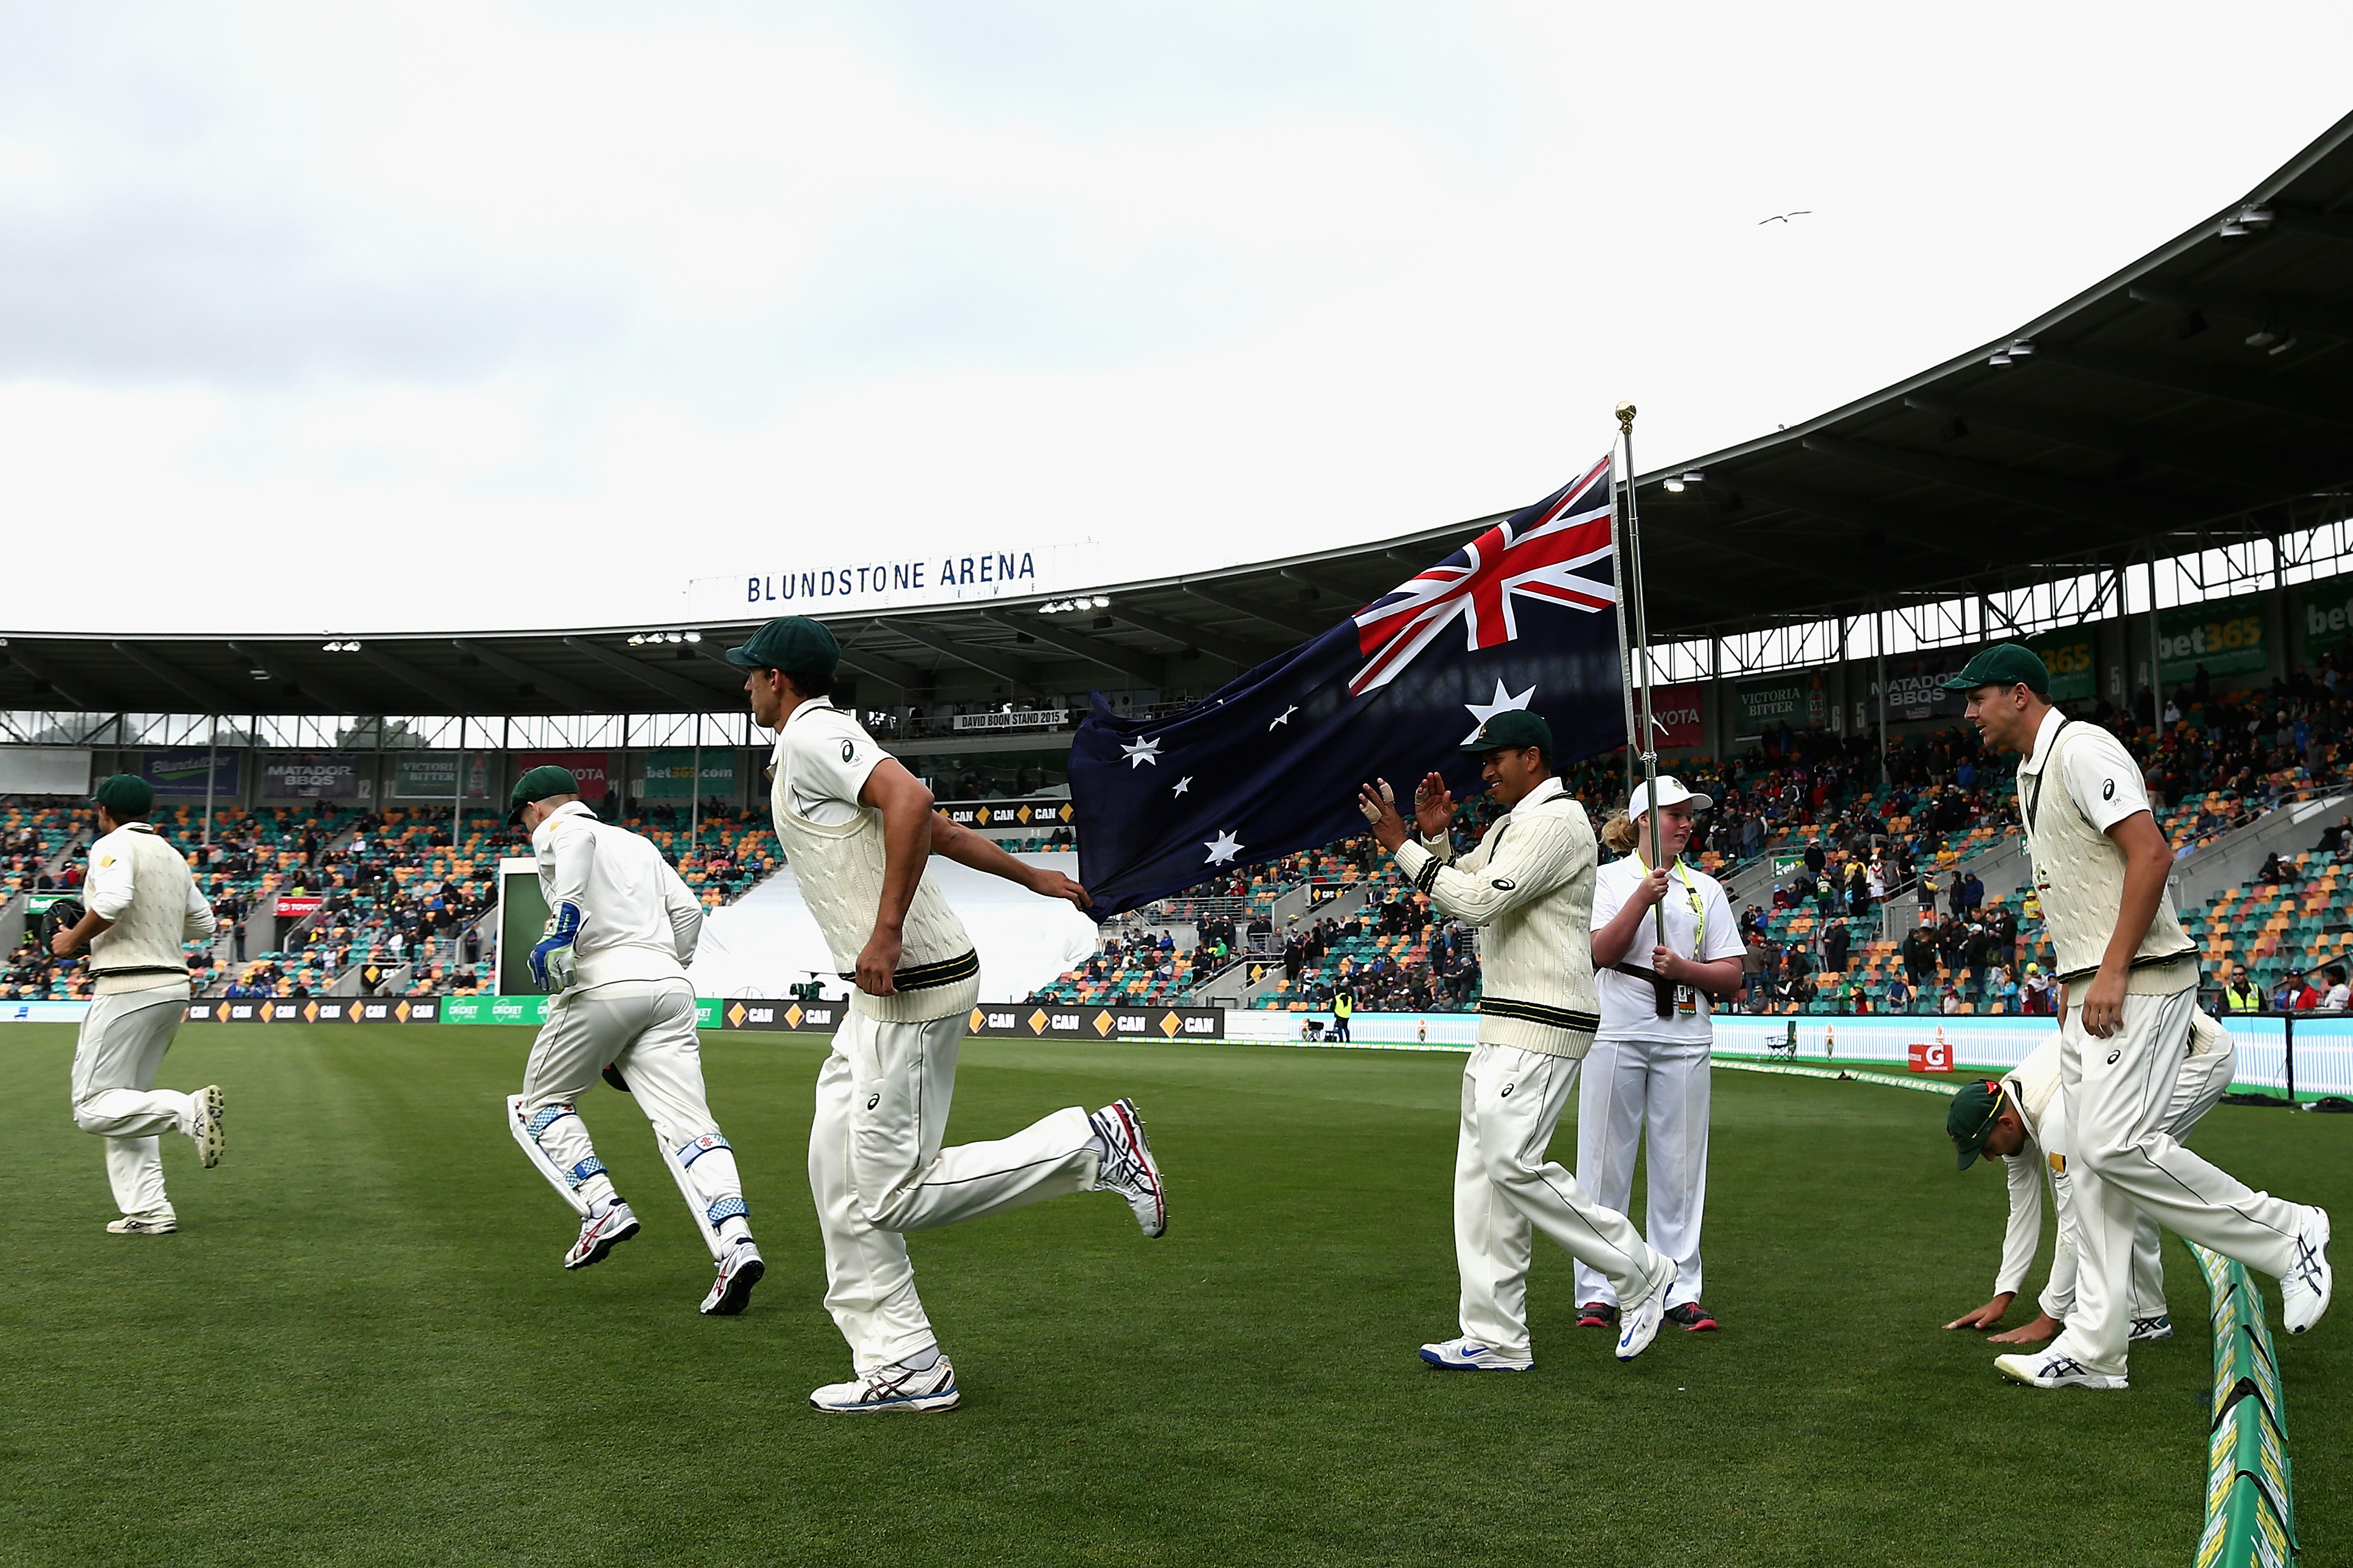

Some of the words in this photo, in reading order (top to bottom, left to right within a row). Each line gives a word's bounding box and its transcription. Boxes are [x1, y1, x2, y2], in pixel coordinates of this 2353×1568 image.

[747, 562, 924, 603] BLUNDSTONE
[940, 552, 1034, 585] ARENA
[2159, 616, 2261, 658] bet365
[2035, 643, 2090, 675] 365
[2111, 667, 2120, 695] 5
[1741, 688, 1801, 705] VICTORIA
[1890, 688, 1946, 706] BBQS
[1748, 700, 1793, 716] BITTER
[1857, 702, 1865, 728] 5
[962, 717, 985, 727] DAVID
[988, 714, 1010, 726] BOON
[1012, 713, 1038, 725] STAND
[1041, 711, 1059, 722] 2015
[1635, 708, 1699, 728] TYOTA
[1832, 706, 1840, 731] 6
[268, 766, 355, 775] MATADOR
[409, 772, 454, 781] BITTER
[646, 766, 733, 778] bet365.com
[285, 776, 334, 786] BBQS
[953, 811, 973, 822] CAN
[994, 810, 1014, 821] CAN
[1035, 808, 1056, 820] CAN
[30, 898, 60, 909] bet
[190, 1006, 210, 1018] CAN
[232, 1006, 252, 1018] CAN
[275, 1005, 297, 1018] CAN
[320, 1005, 341, 1018] CAN
[365, 1005, 387, 1018] CAN
[412, 1005, 434, 1018] CAN
[749, 1008, 774, 1023] CAN
[805, 1009, 831, 1024] CAN
[988, 1013, 1015, 1028] CAN
[1052, 1014, 1079, 1030] CAN
[1117, 1016, 1146, 1032] CAN
[1185, 1017, 1214, 1033] CAN
[1925, 1045, 1945, 1066] G
